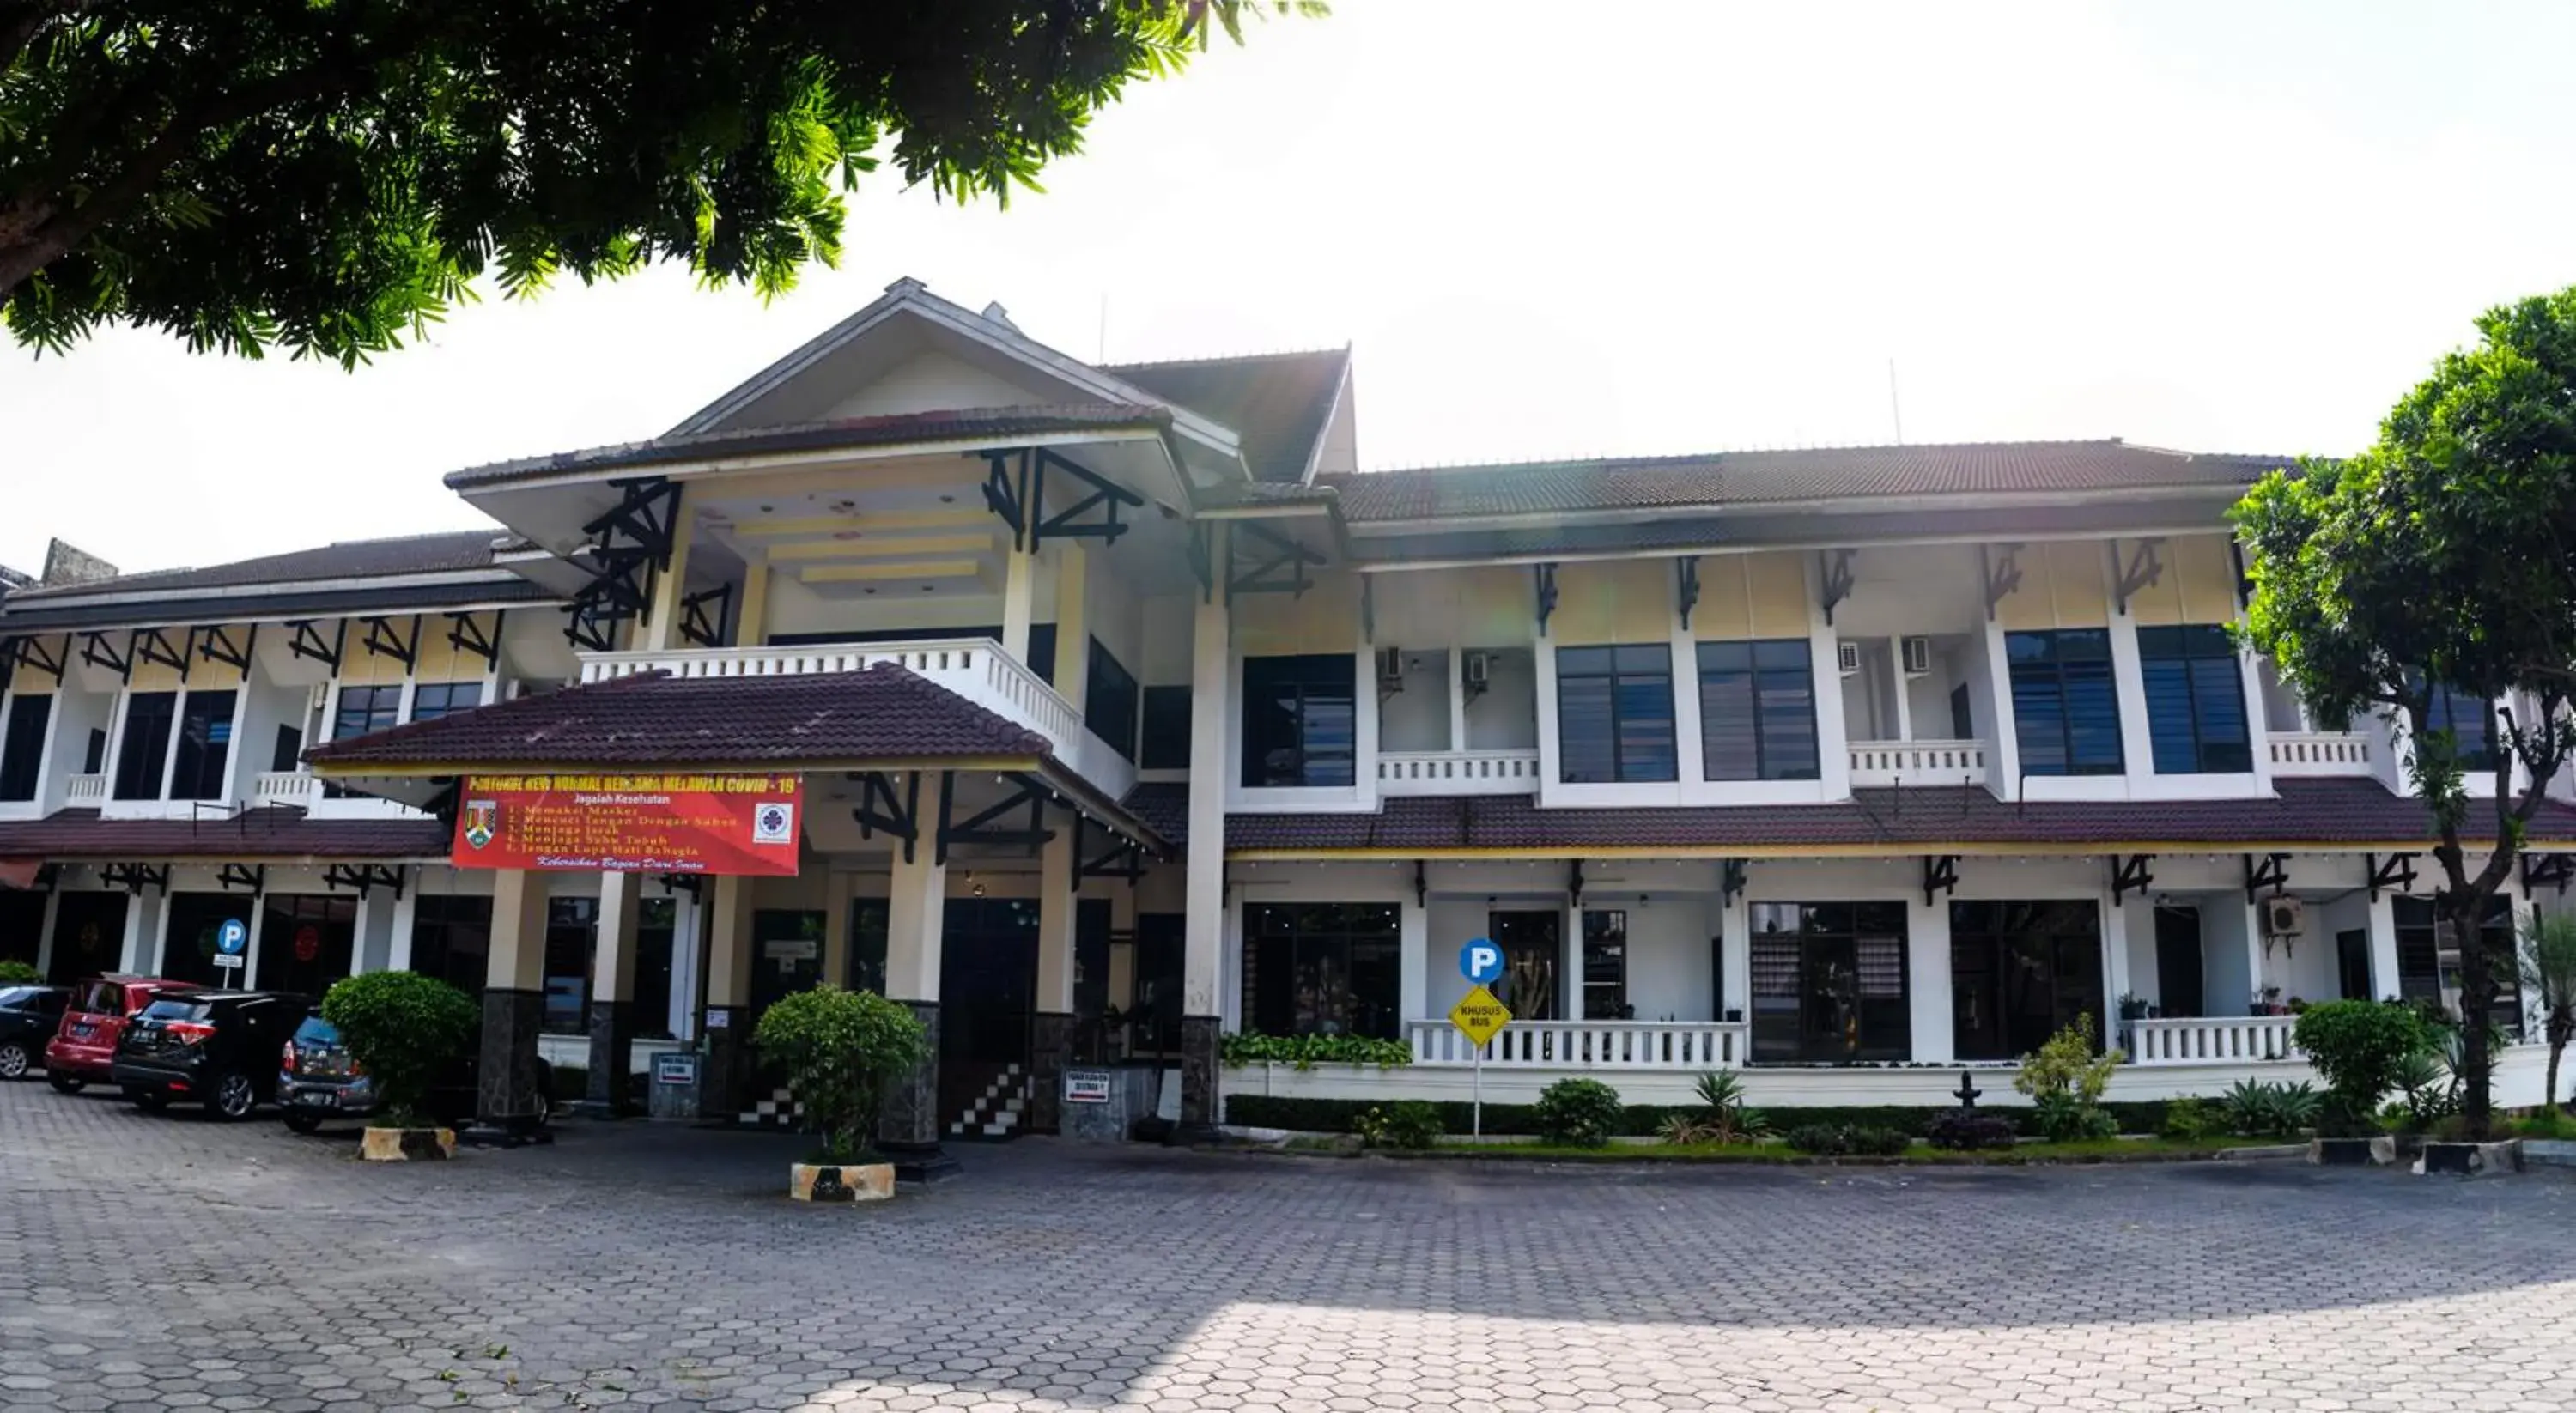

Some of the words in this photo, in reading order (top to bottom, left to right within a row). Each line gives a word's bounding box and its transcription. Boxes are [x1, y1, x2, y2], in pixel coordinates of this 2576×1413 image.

[525, 775, 550, 791] NEW
[554, 775, 602, 791] NORMAL
[604, 775, 661, 791] BERSAMA
[663, 776, 724, 792] MELAWAN
[726, 777, 769, 793] COVID
[778, 779, 795, 794] 19
[574, 793, 613, 805] Jagalah
[614, 794, 670, 805] Kesehatan
[524, 806, 584, 816] Memakai
[589, 806, 637, 816] Masker
[524, 815, 580, 824] Mencuci
[585, 815, 633, 827] Tangan
[638, 816, 688, 828] Dengan
[523, 824, 580, 836] Menjaga
[522, 834, 580, 846] Menjaga
[628, 835, 668, 846] Tubuh
[521, 844, 568, 856] Jangan
[574, 845, 606, 856] Lupa
[612, 845, 640, 855] Hati
[645, 846, 700, 858] Bahagia
[537, 856, 598, 866] Kebersihan
[225, 925, 241, 949] P
[1471, 947, 1497, 978] P
[1461, 1005, 1502, 1015] KHUSUS
[1470, 1016, 1490, 1027] BUS
